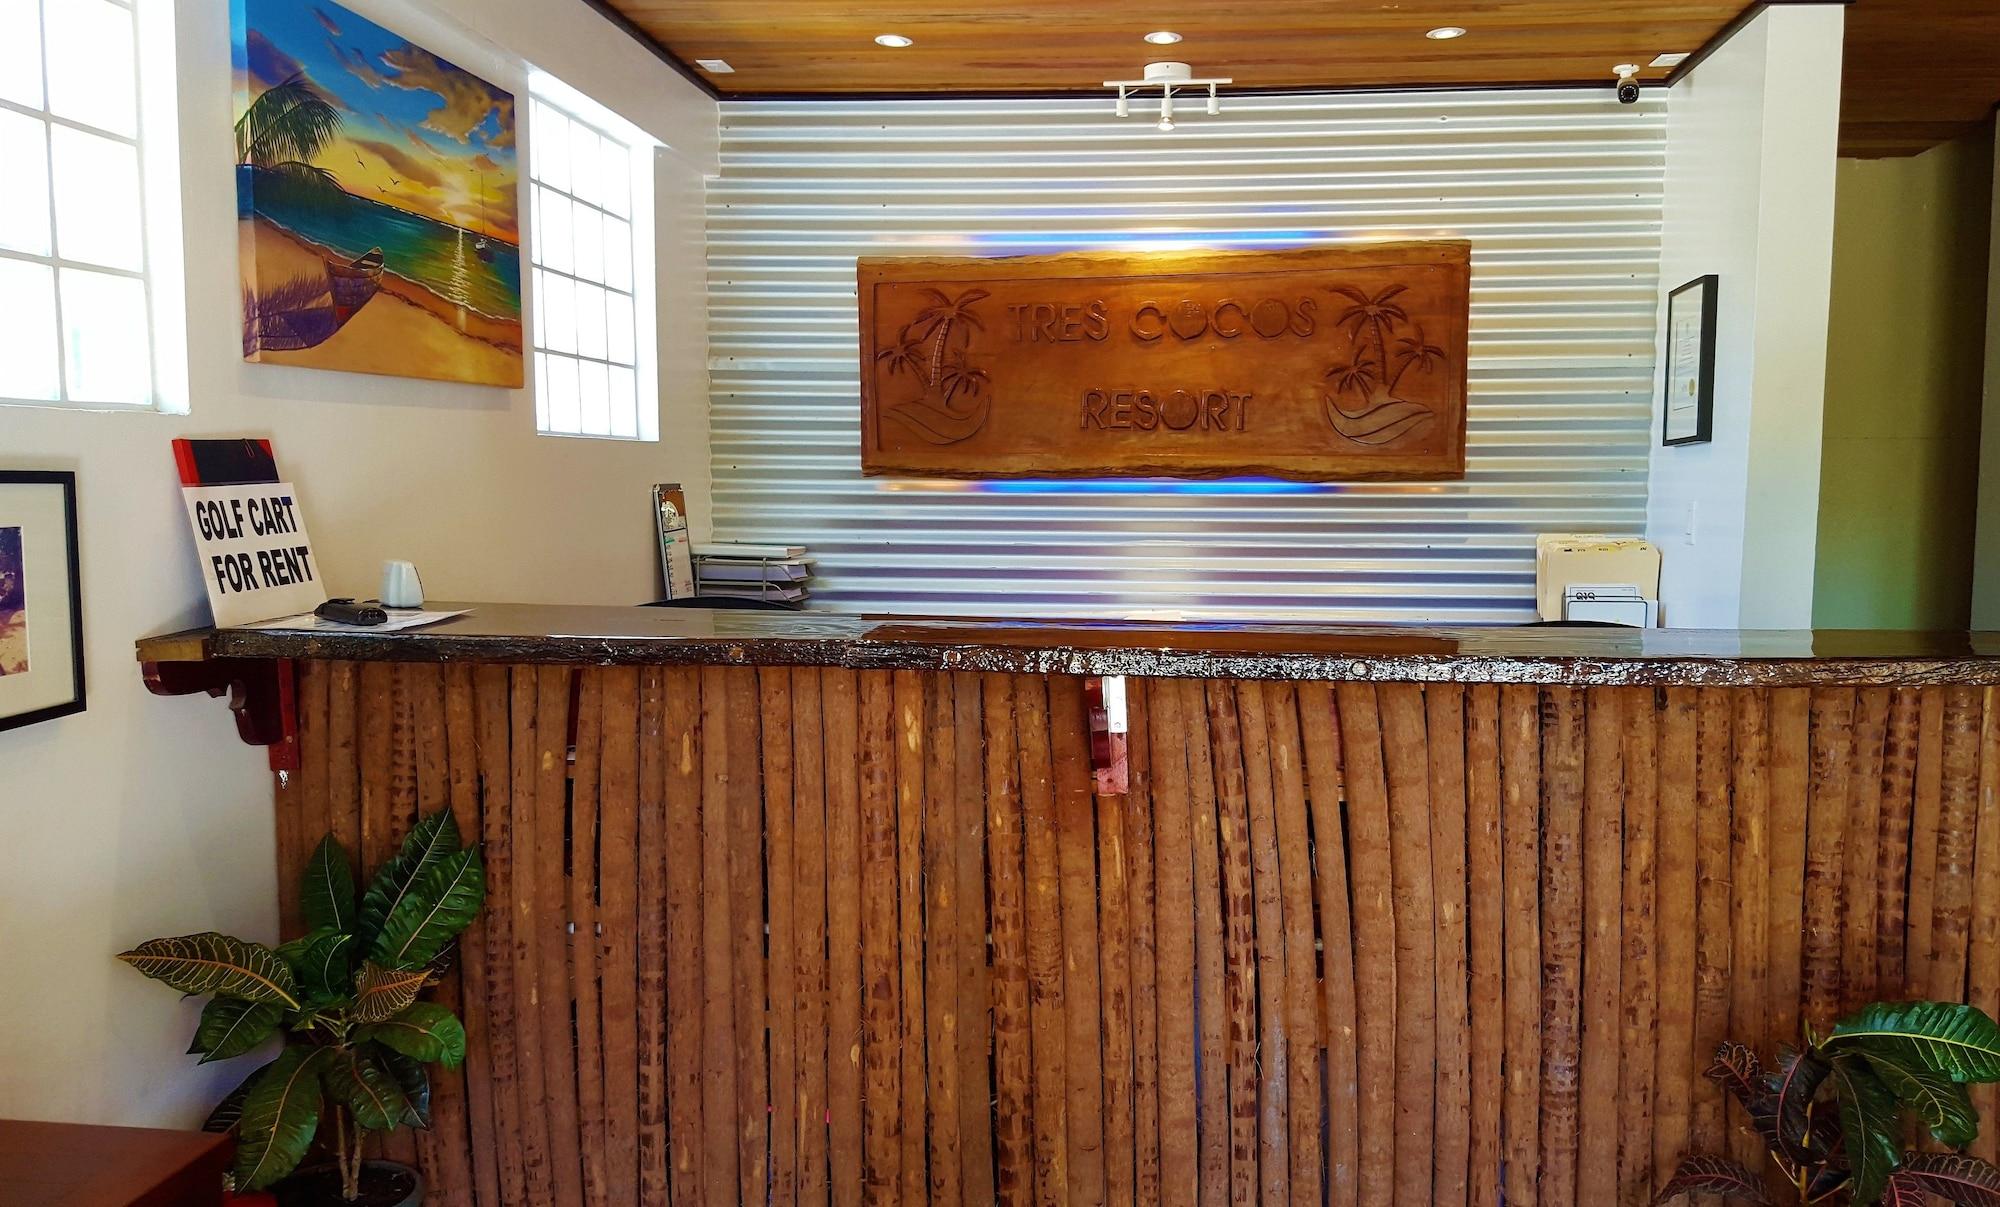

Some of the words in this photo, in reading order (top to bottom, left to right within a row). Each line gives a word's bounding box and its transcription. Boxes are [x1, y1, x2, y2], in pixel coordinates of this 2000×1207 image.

[1007, 300, 1110, 343] TRES
[1129, 298, 1318, 341] COCOS
[1080, 388, 1253, 431] RESORT
[196, 499, 244, 541] GOLF
[247, 496, 298, 536] CART
[211, 552, 260, 594] FOR
[256, 546, 313, 588] RENT
